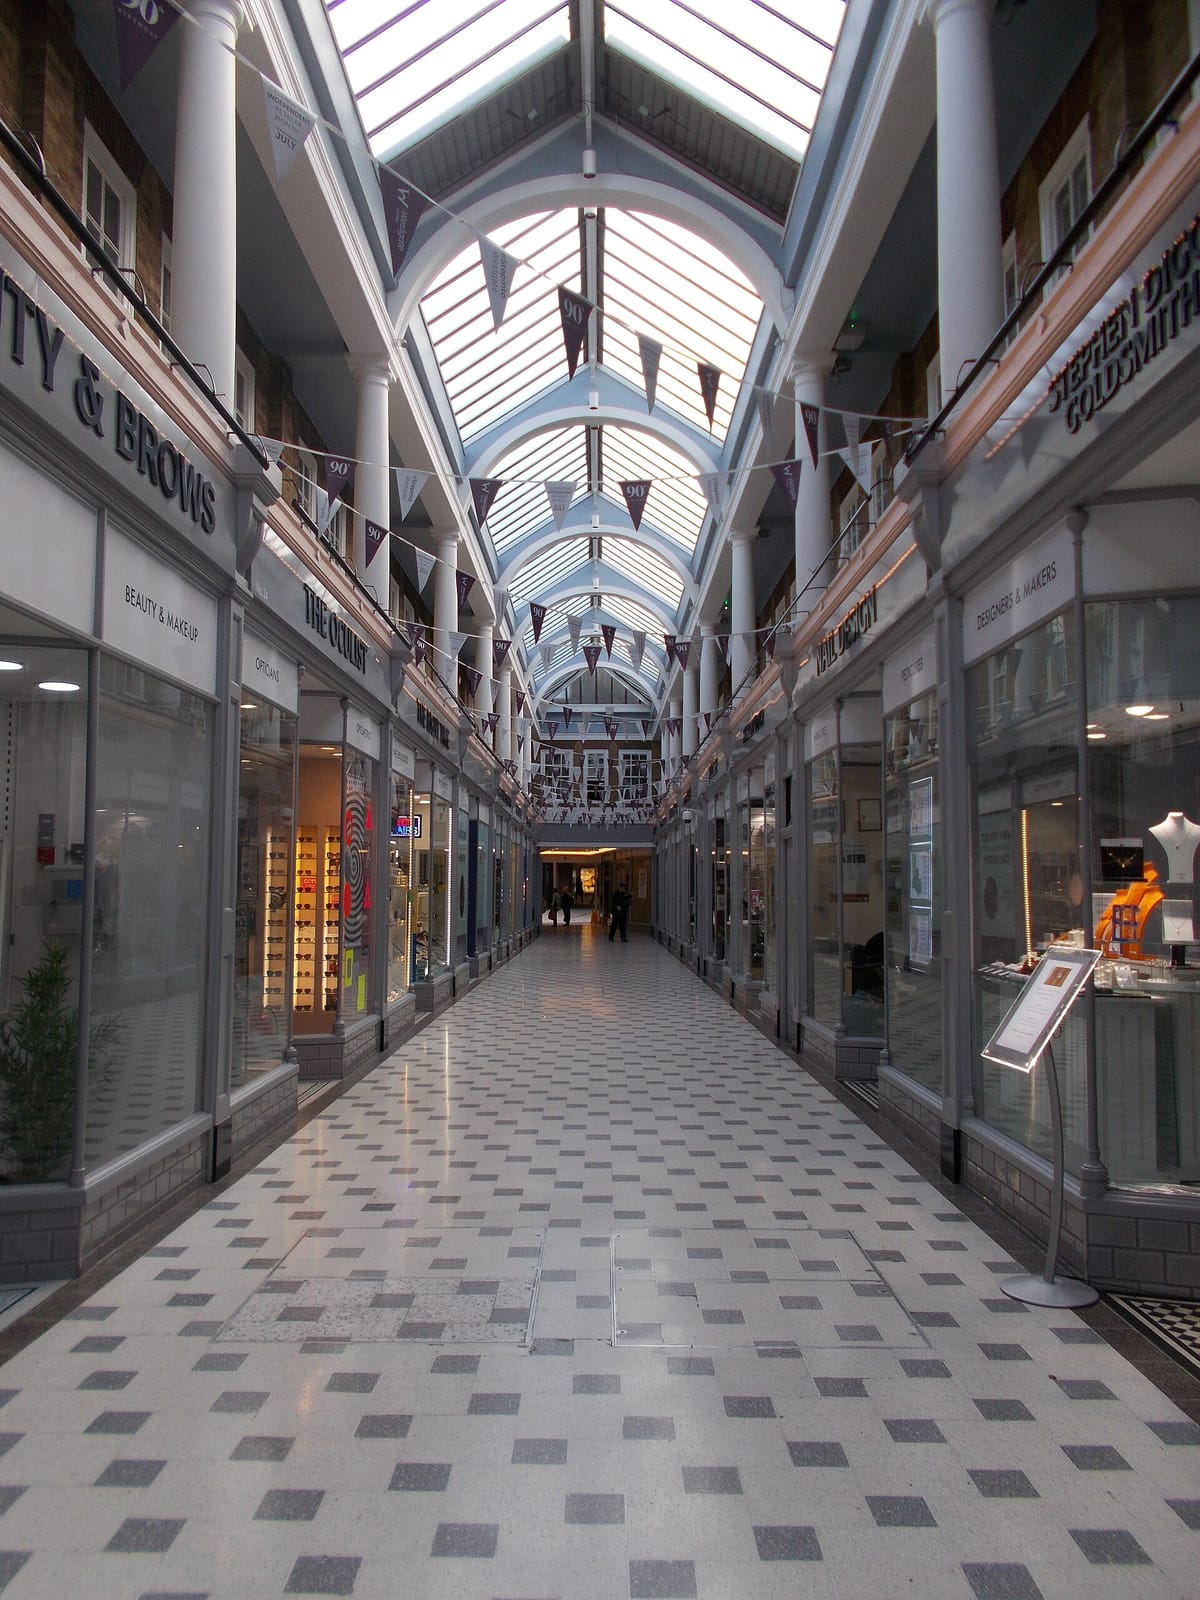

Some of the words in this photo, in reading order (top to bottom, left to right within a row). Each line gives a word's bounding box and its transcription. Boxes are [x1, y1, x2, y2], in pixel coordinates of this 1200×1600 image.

[267, 92, 310, 126] INDEPENDENT
[275, 131, 297, 151] JULY
[1047, 286, 1139, 413] STEPHEN
[1065, 269, 1200, 435] GOLDSMITH
[0, 268, 65, 392] TY
[75, 353, 104, 438] &
[115, 388, 216, 534] BROWS
[125, 584, 158, 619] BEAUTY
[158, 606, 165, 625] &
[166, 611, 199, 643] MAKE-UP
[303, 583, 328, 640] THE
[329, 612, 369, 675] OCULIST
[816, 629, 839, 677] NAIL
[838, 583, 878, 657] DESIGN
[976, 592, 1013, 631] DESIGNERS
[1015, 587, 1021, 605] &
[1023, 560, 1057, 599] MAKERS
[255, 657, 280, 683] OPTICIANS
